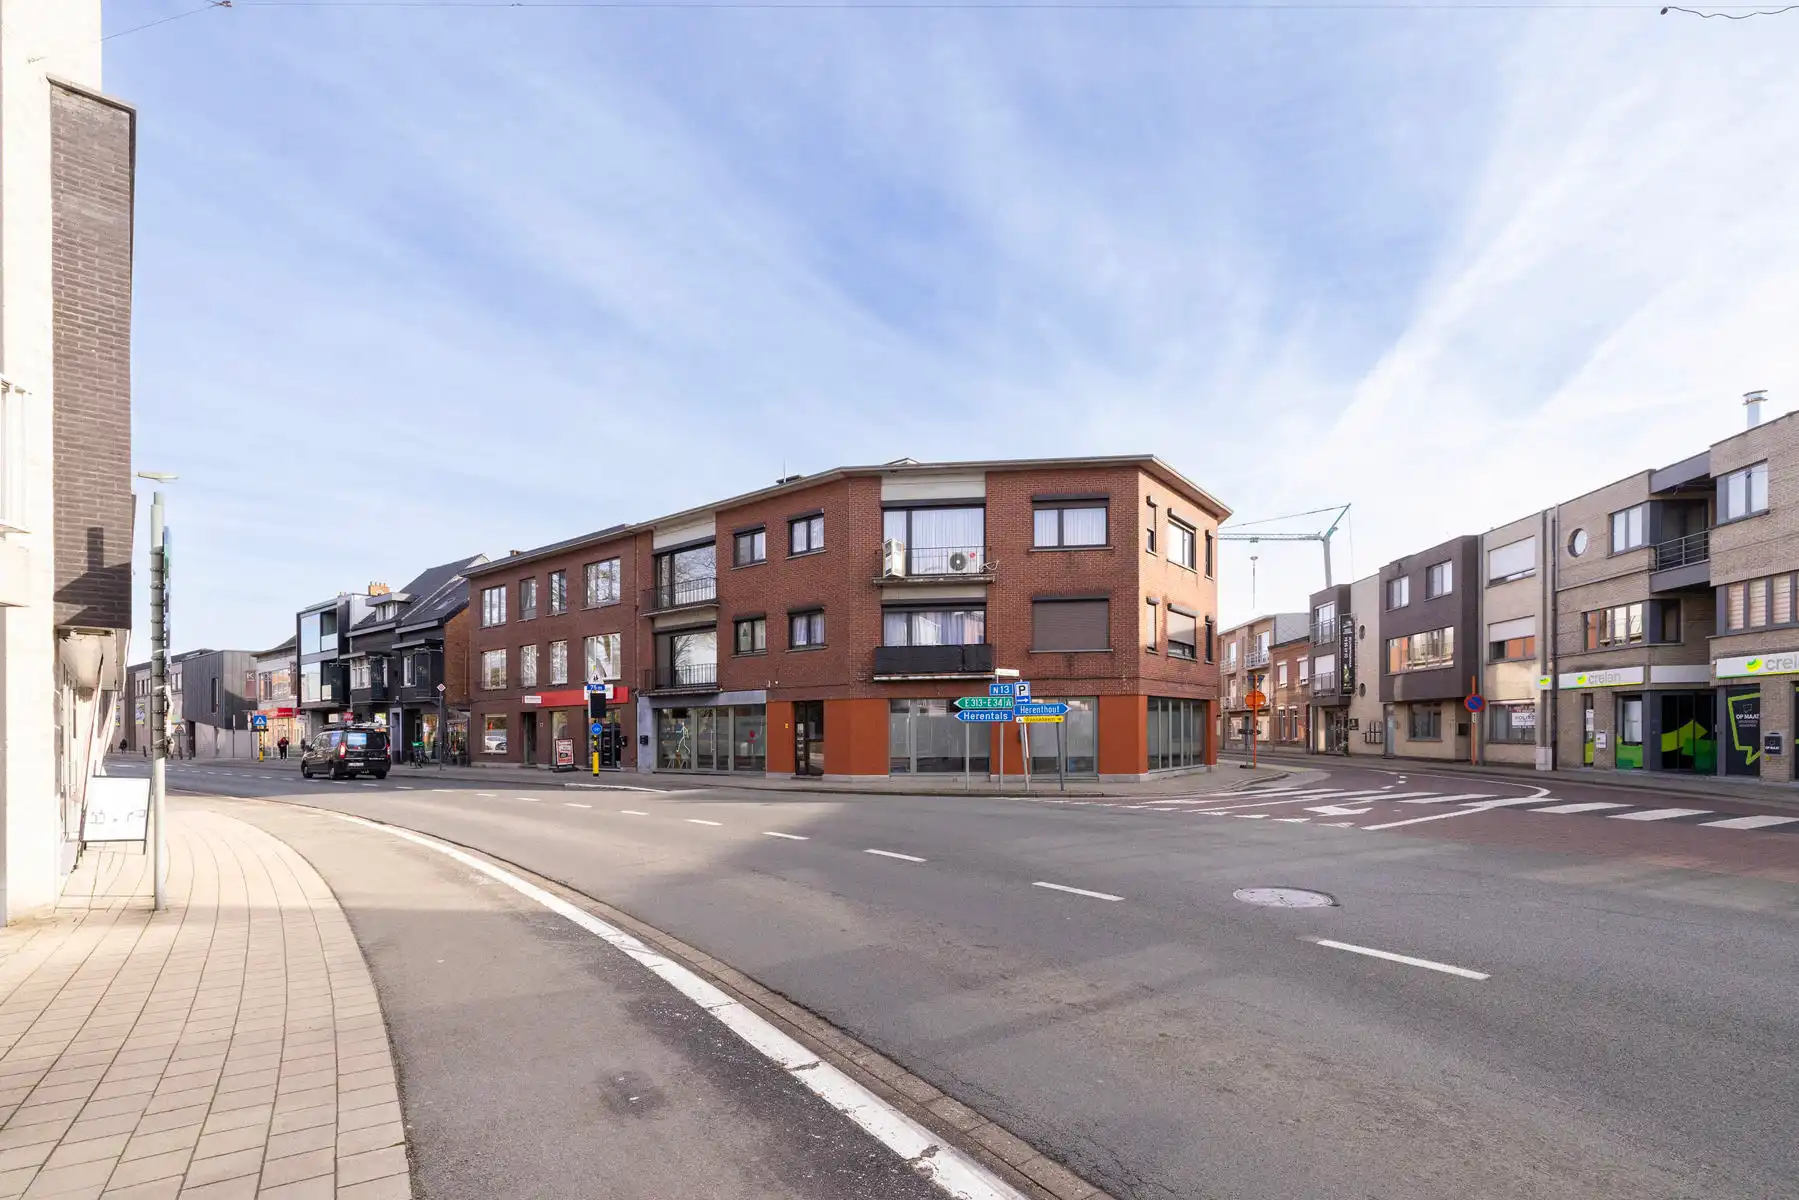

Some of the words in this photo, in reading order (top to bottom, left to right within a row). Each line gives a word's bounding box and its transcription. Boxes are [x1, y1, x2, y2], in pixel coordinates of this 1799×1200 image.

[1766, 654, 1799, 671] crel
[1588, 671, 1622, 685] crelan
[1018, 685, 1026, 696] P
[1020, 705, 1060, 714] Herenthout
[963, 711, 1008, 720] Herentals
